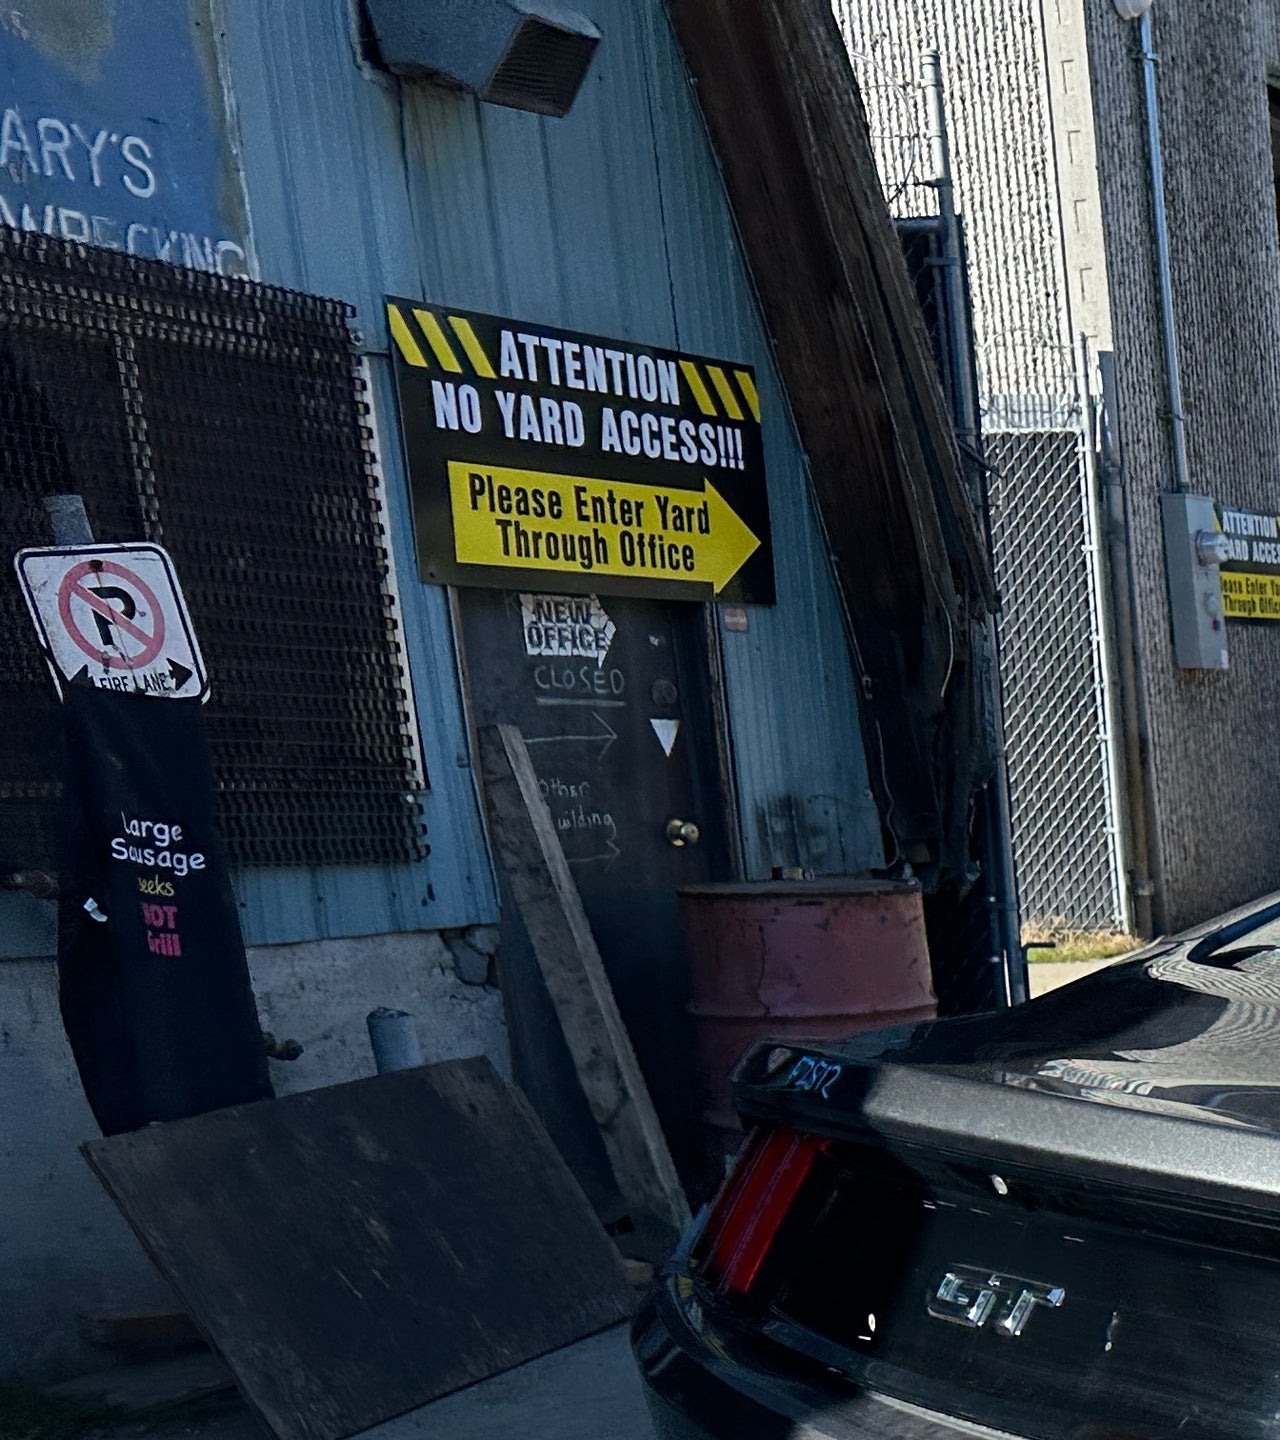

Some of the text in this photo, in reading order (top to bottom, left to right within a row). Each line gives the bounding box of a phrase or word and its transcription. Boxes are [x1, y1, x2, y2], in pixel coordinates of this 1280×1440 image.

[500, 329, 680, 406] ATTENTION
[431, 379, 746, 471] NO YARD ACCESS!!!
[468, 473, 711, 535] Please Enter Yard
[1222, 511, 1277, 538] ATTENTION
[495, 519, 695, 572] Through Office
[1228, 539, 1249, 561] ARD
[1222, 579, 1243, 594] ease
[1245, 577, 1267, 595] Enter
[534, 600, 591, 624] NEW
[1223, 594, 1257, 616] Through
[527, 622, 610, 651] OFFICE
[100, 677, 130, 692] FIRE
[534, 665, 626, 695] CLOSED
[557, 805, 617, 840] uilding
[784, 1056, 841, 1100] F2512
[928, 1263, 1066, 1337] GT
